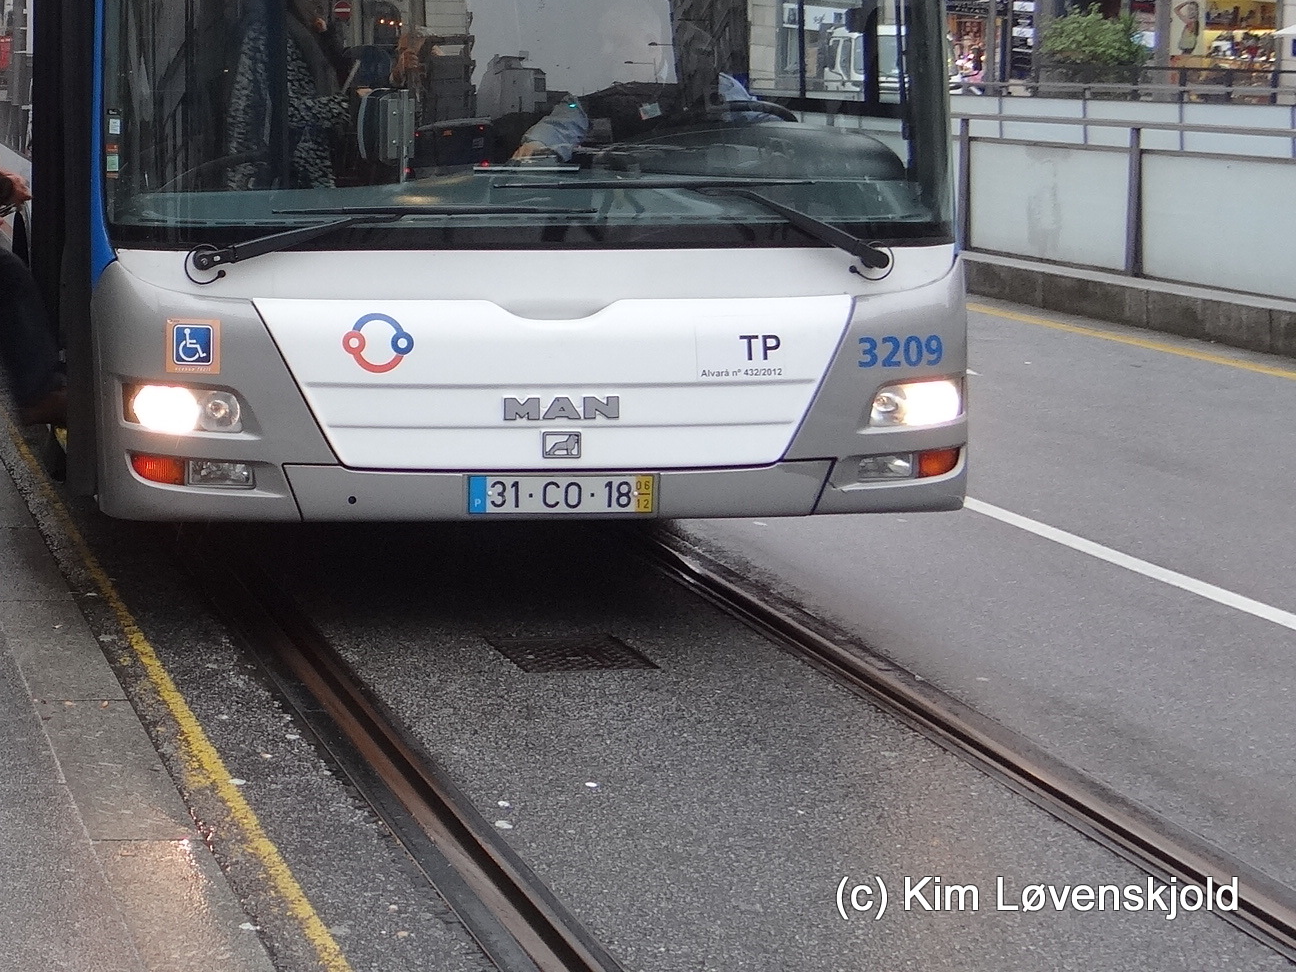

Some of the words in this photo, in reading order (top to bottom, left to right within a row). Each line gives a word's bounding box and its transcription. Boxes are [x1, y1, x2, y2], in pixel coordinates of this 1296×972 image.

[739, 335, 781, 361] TP
[857, 335, 943, 368] 3209
[701, 369, 729, 377] Alvará
[744, 368, 783, 377] 432/2012
[503, 396, 620, 421] MAN
[635, 480, 651, 491] 06
[474, 499, 482, 508] P
[636, 499, 650, 509] 12
